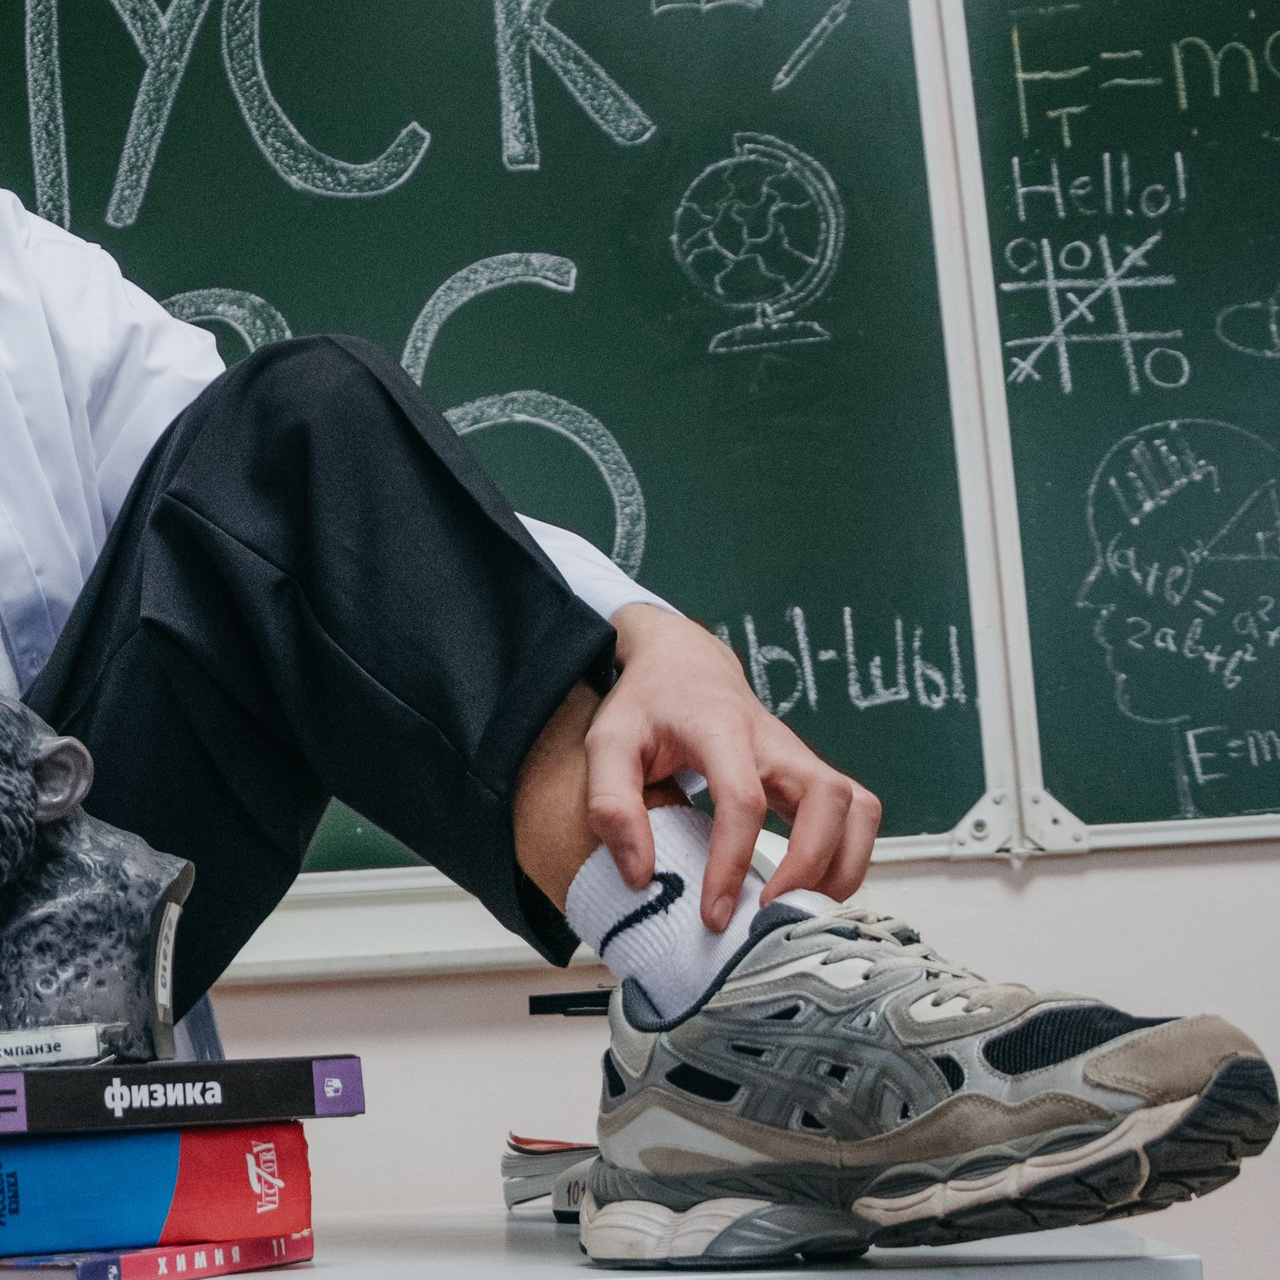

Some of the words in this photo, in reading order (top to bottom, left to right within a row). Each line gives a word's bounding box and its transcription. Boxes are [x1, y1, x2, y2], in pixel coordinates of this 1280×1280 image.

[717, 606, 967, 718] Ы-ШЫ
[104, 1077, 222, 1118] физика
[6, 1170, 19, 1215] ЯЗЫКА
[158, 1245, 241, 1276] ХИМИЯ
[272, 1238, 287, 1257] 11
